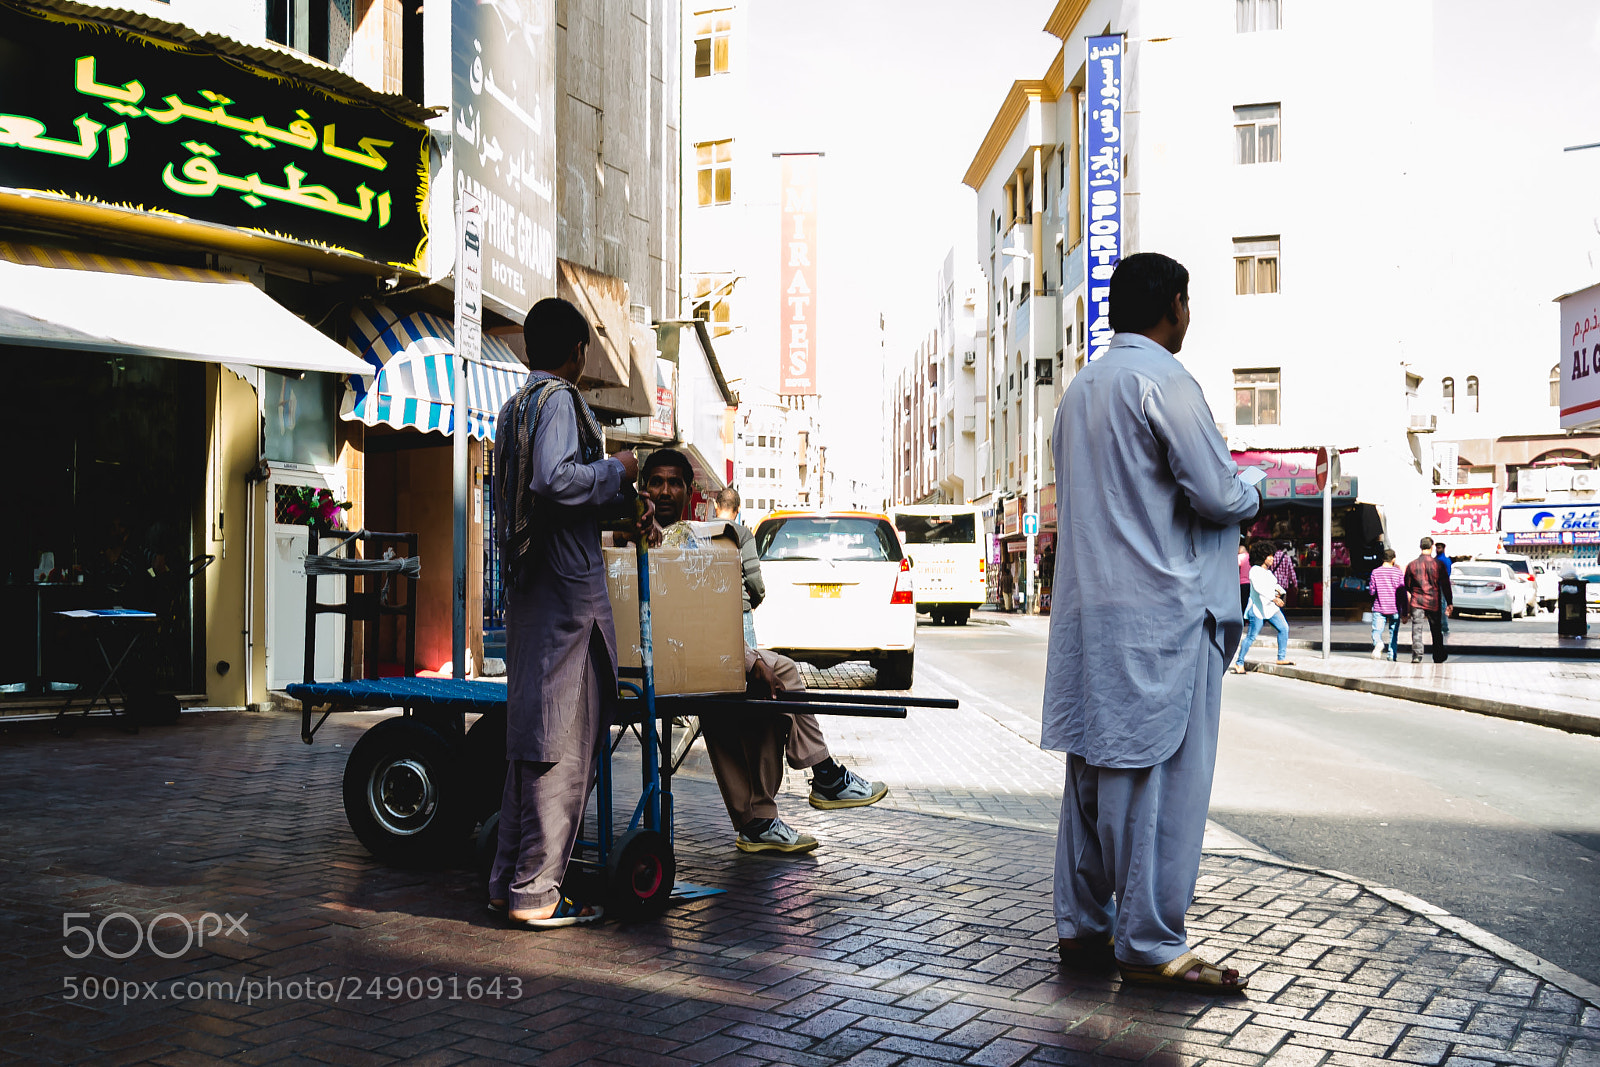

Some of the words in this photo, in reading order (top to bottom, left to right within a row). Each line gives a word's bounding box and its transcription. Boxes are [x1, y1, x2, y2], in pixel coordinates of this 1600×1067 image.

[75, 55, 394, 171] كافيتريا
[470, 38, 542, 136] فندق
[161, 140, 392, 229] الطبق
[517, 211, 553, 281] GRAND
[1089, 190, 1119, 280] SPORTS
[491, 257, 526, 296] HOTEL
[1571, 347, 1590, 381] AL
[1561, 520, 1600, 529] GREE
